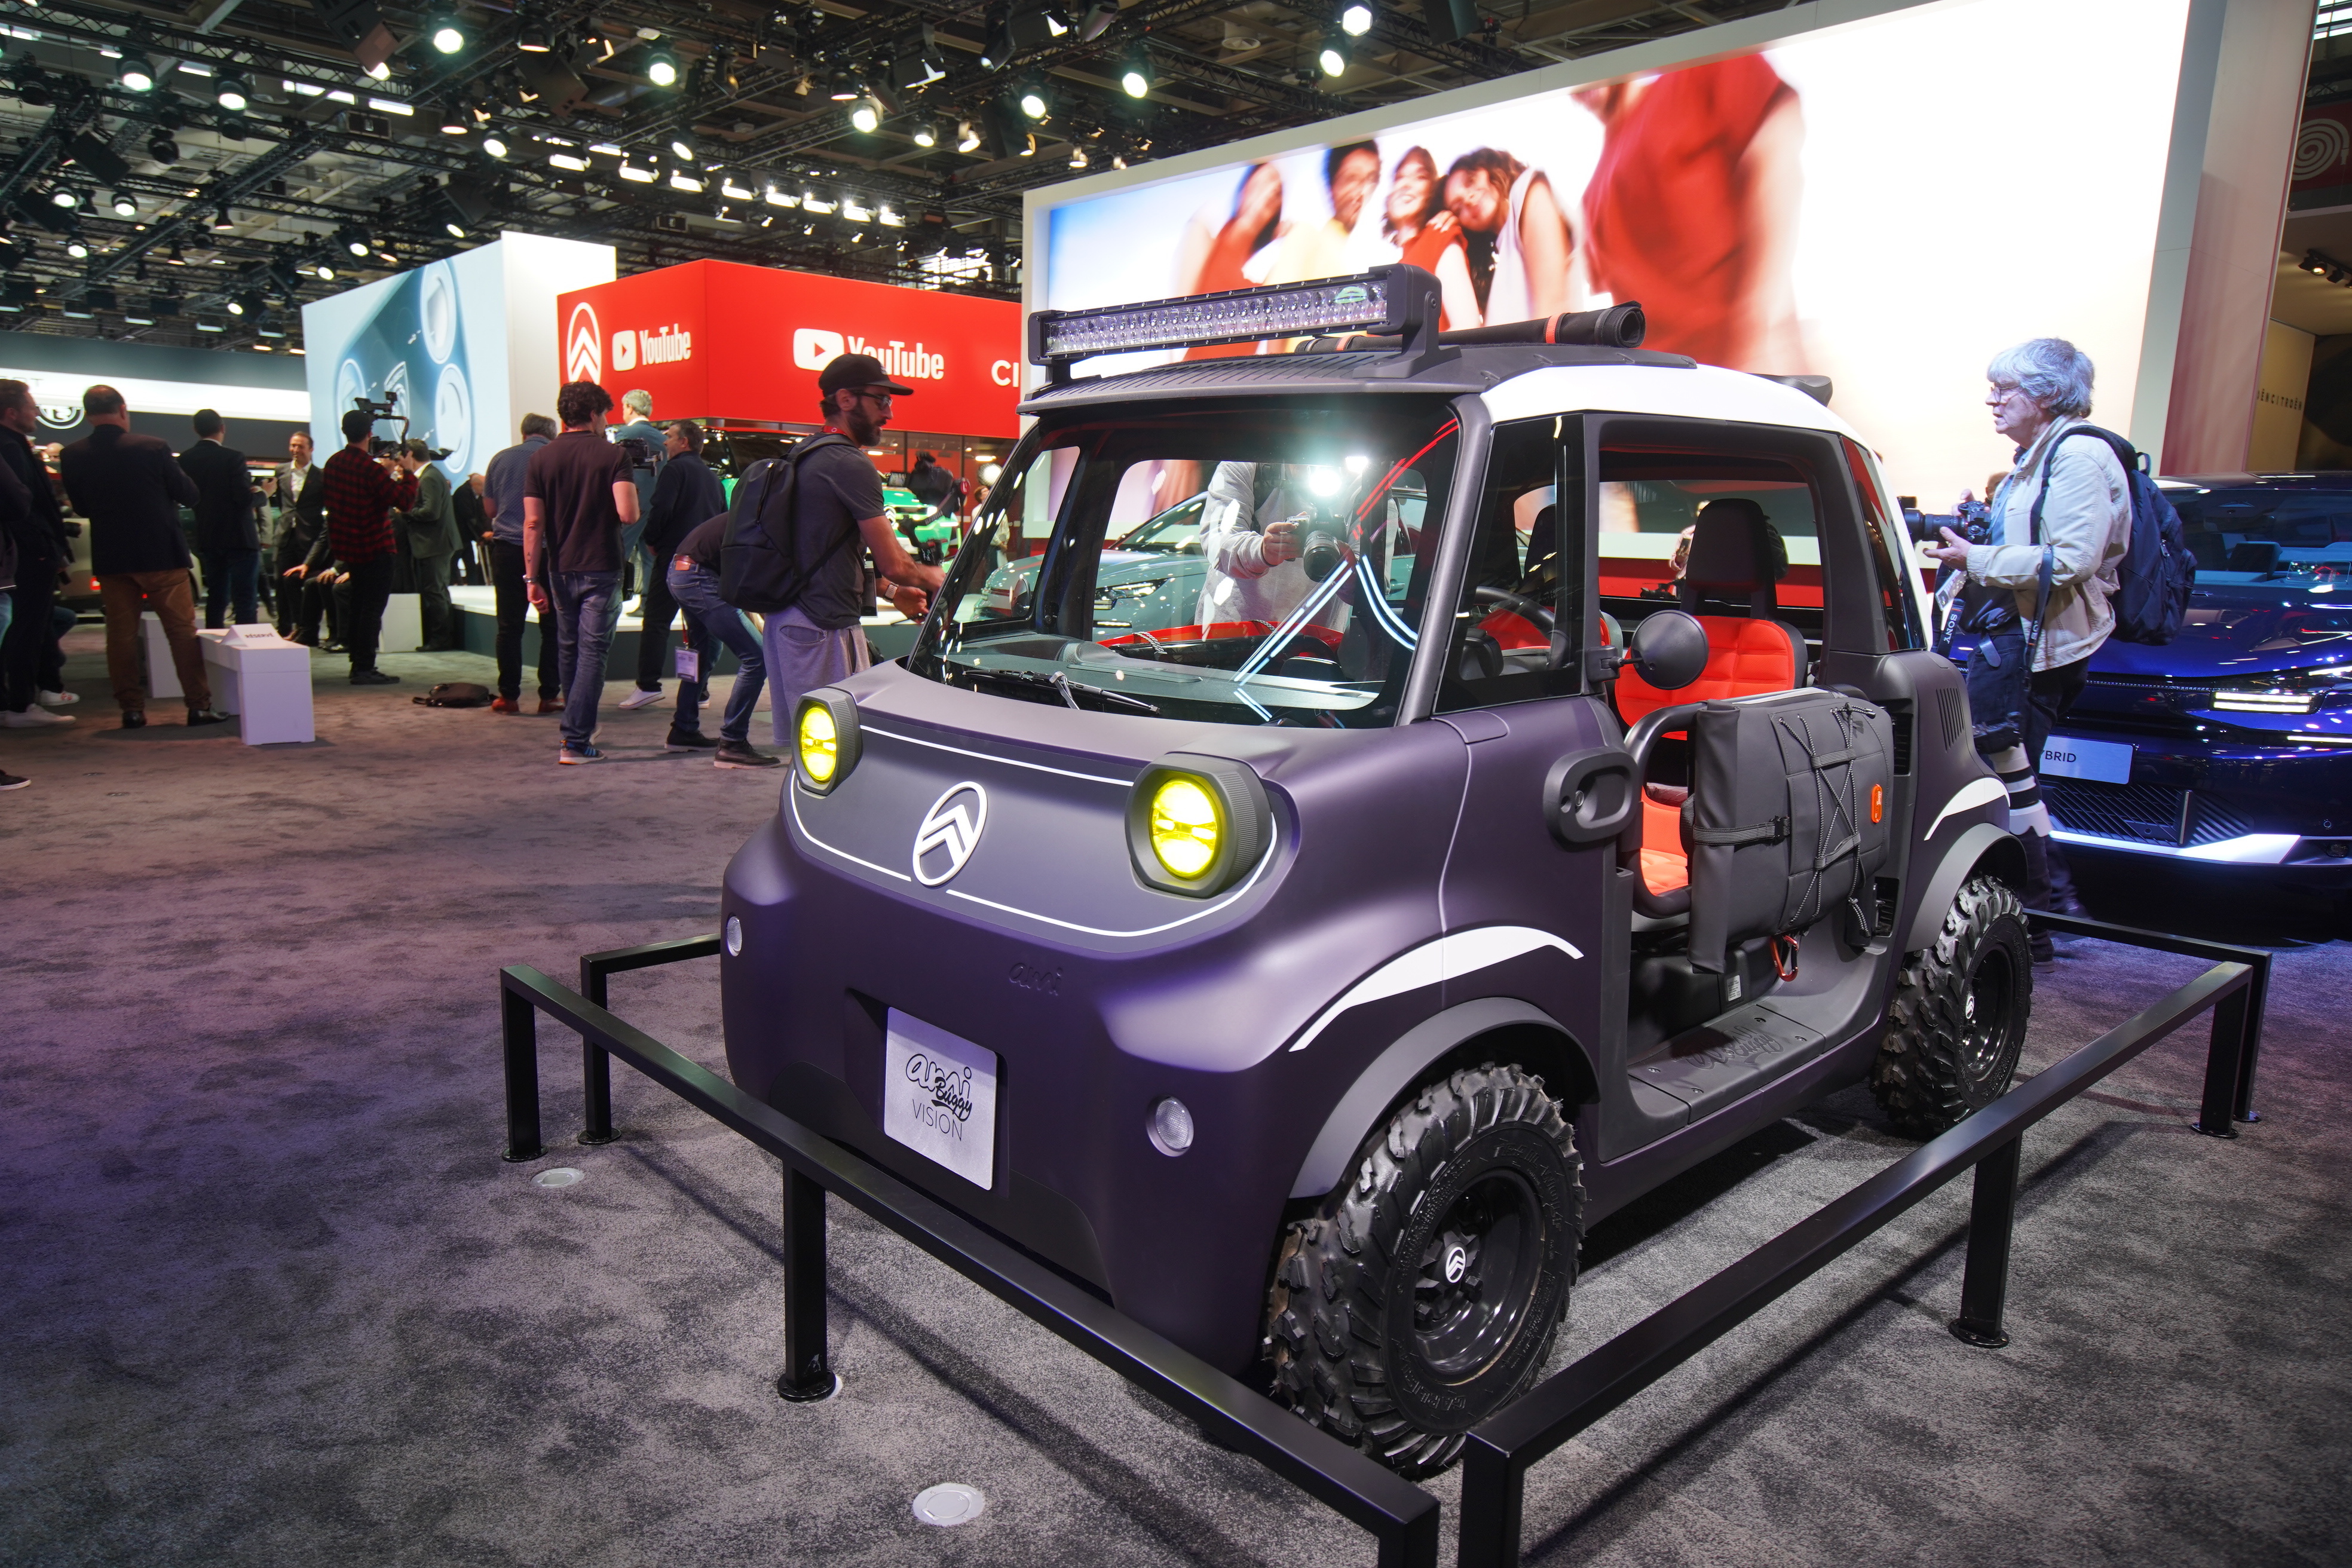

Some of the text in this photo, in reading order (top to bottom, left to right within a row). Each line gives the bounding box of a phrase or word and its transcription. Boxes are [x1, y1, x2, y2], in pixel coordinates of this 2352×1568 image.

[639, 323, 691, 365] YouTube
[1943, 613, 1958, 644] SONY
[2042, 750, 2077, 762] BRID
[912, 1098, 963, 1142] VISION
